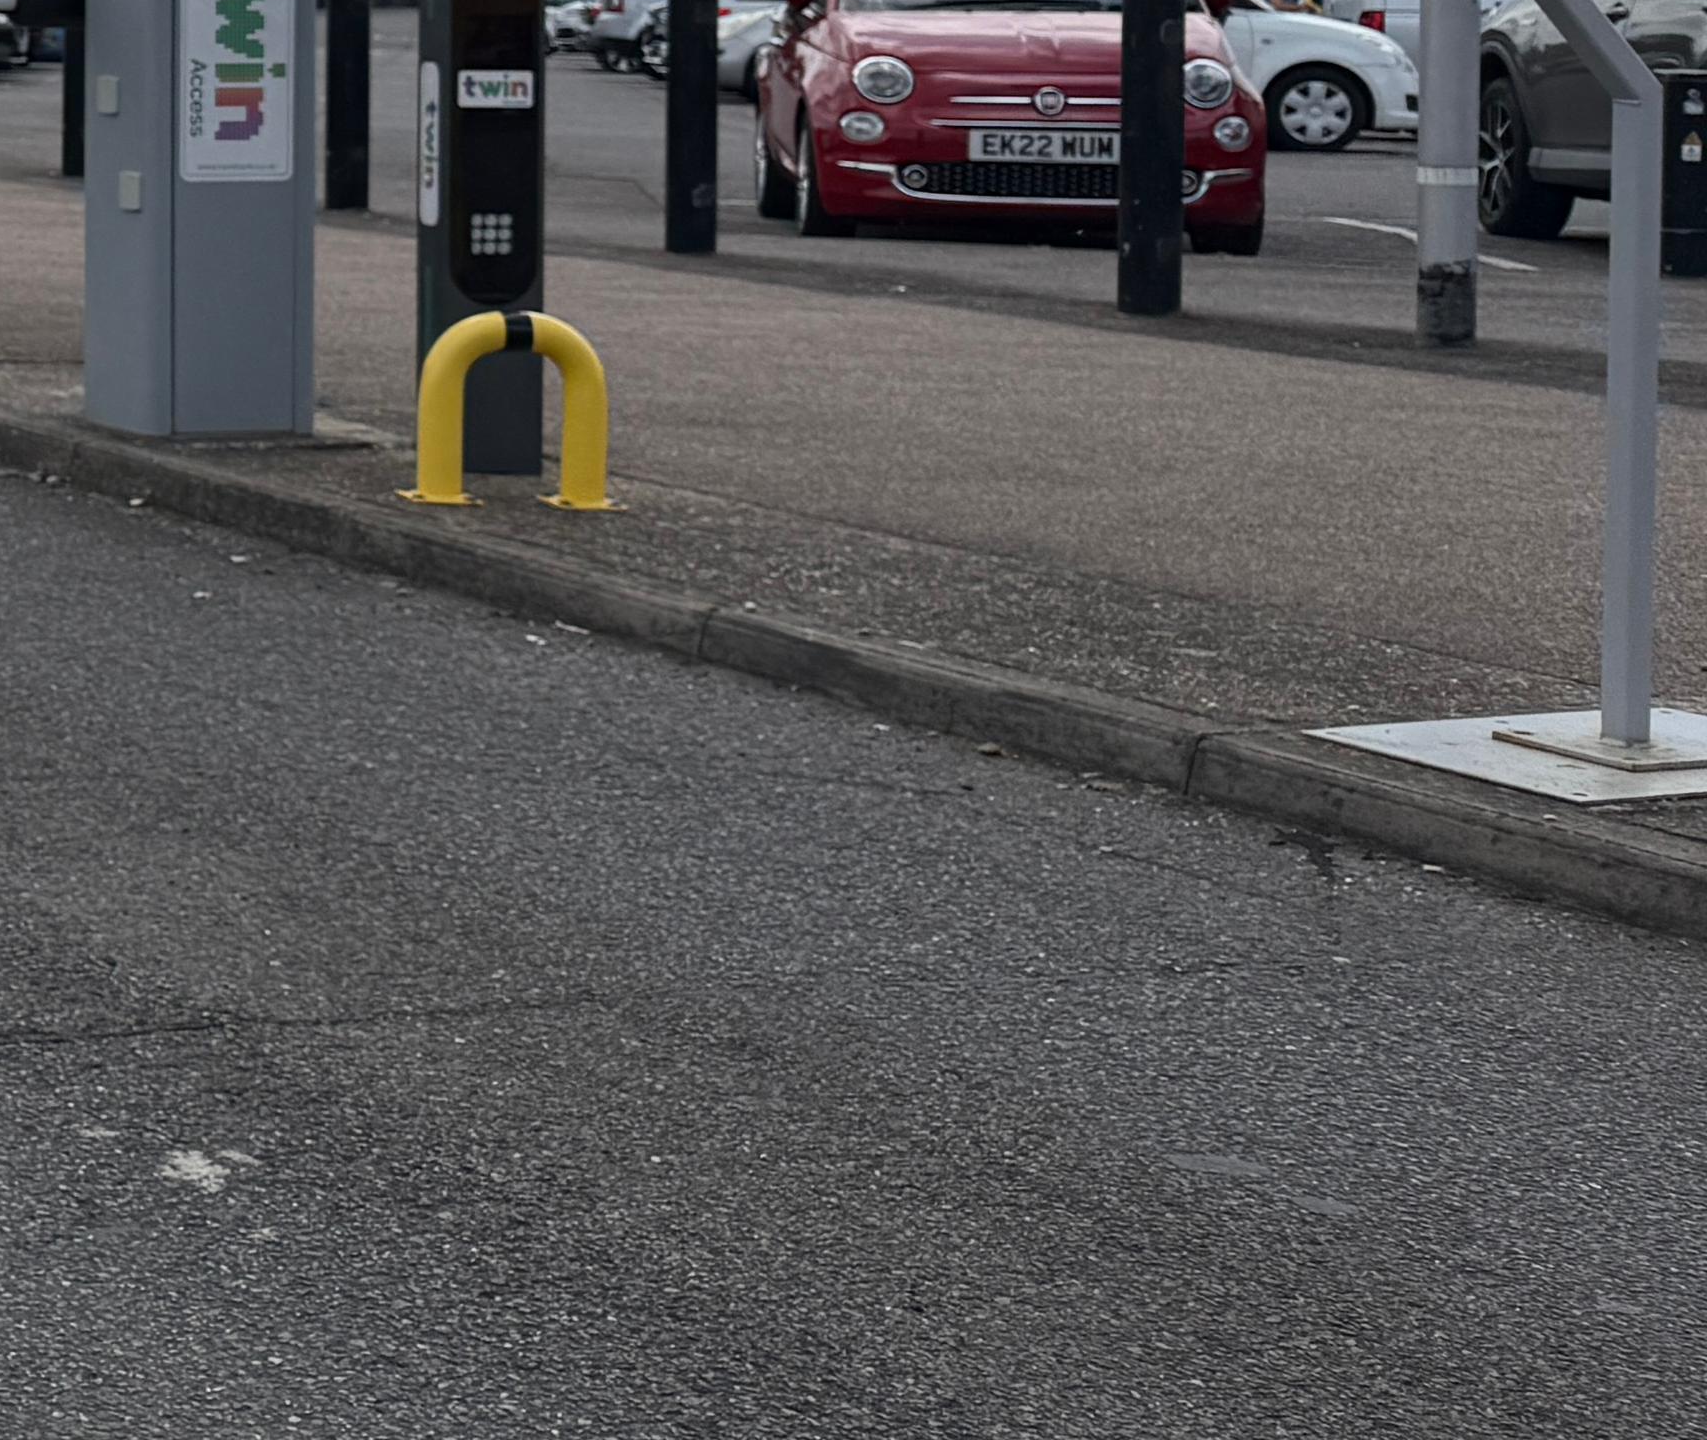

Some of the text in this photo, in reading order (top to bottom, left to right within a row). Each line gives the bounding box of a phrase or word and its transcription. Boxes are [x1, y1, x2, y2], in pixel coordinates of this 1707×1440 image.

[189, 58, 207, 138] Access
[462, 74, 529, 98] twin
[982, 134, 1114, 158] EK22 WUM
